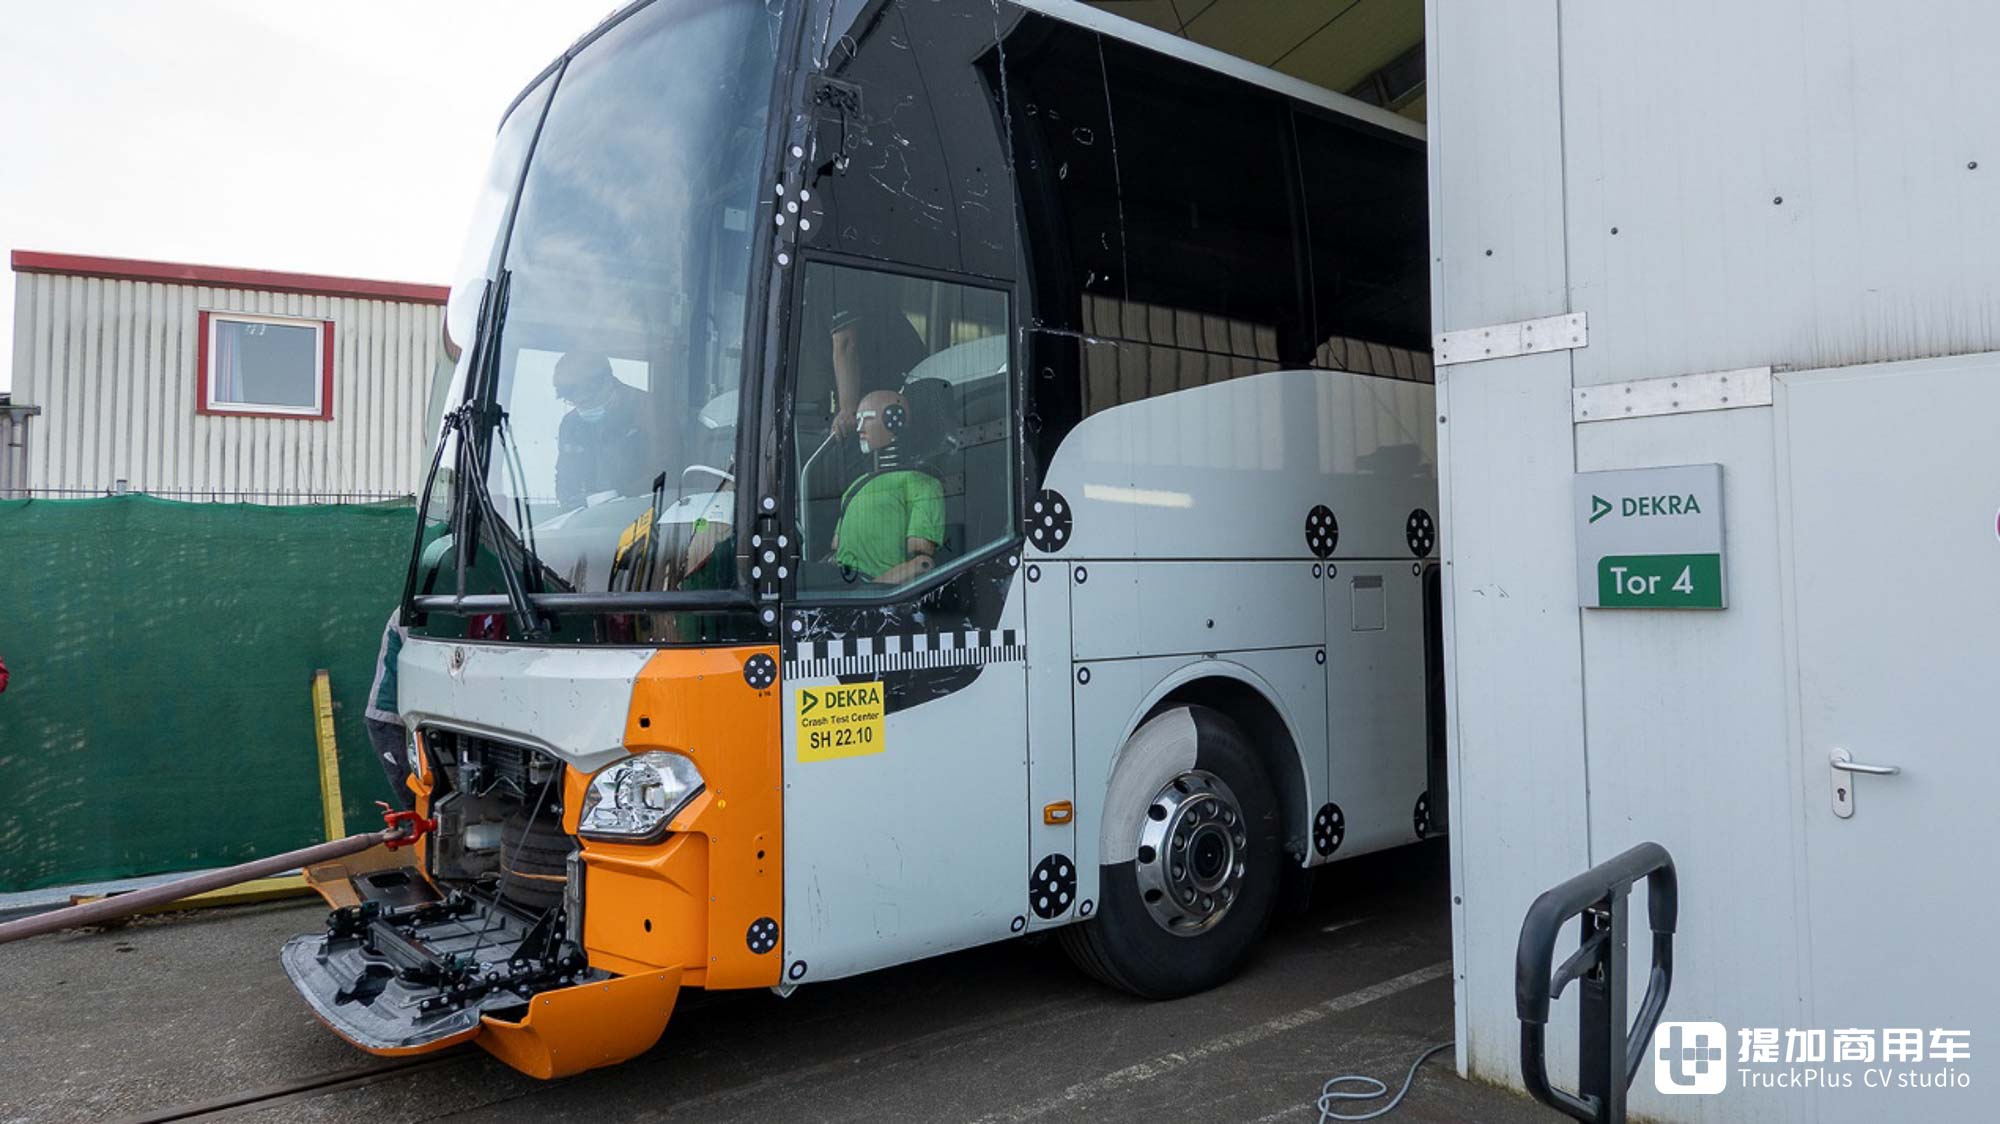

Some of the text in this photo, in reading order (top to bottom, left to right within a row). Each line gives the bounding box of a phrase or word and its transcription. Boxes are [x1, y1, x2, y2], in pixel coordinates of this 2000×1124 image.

[1622, 494, 1701, 517] DEKRA
[1610, 565, 1694, 595] Tor 4
[825, 688, 880, 709] DEKRA
[801, 711, 880, 728] Crash Test Center
[810, 726, 872, 749] SH 22.10
